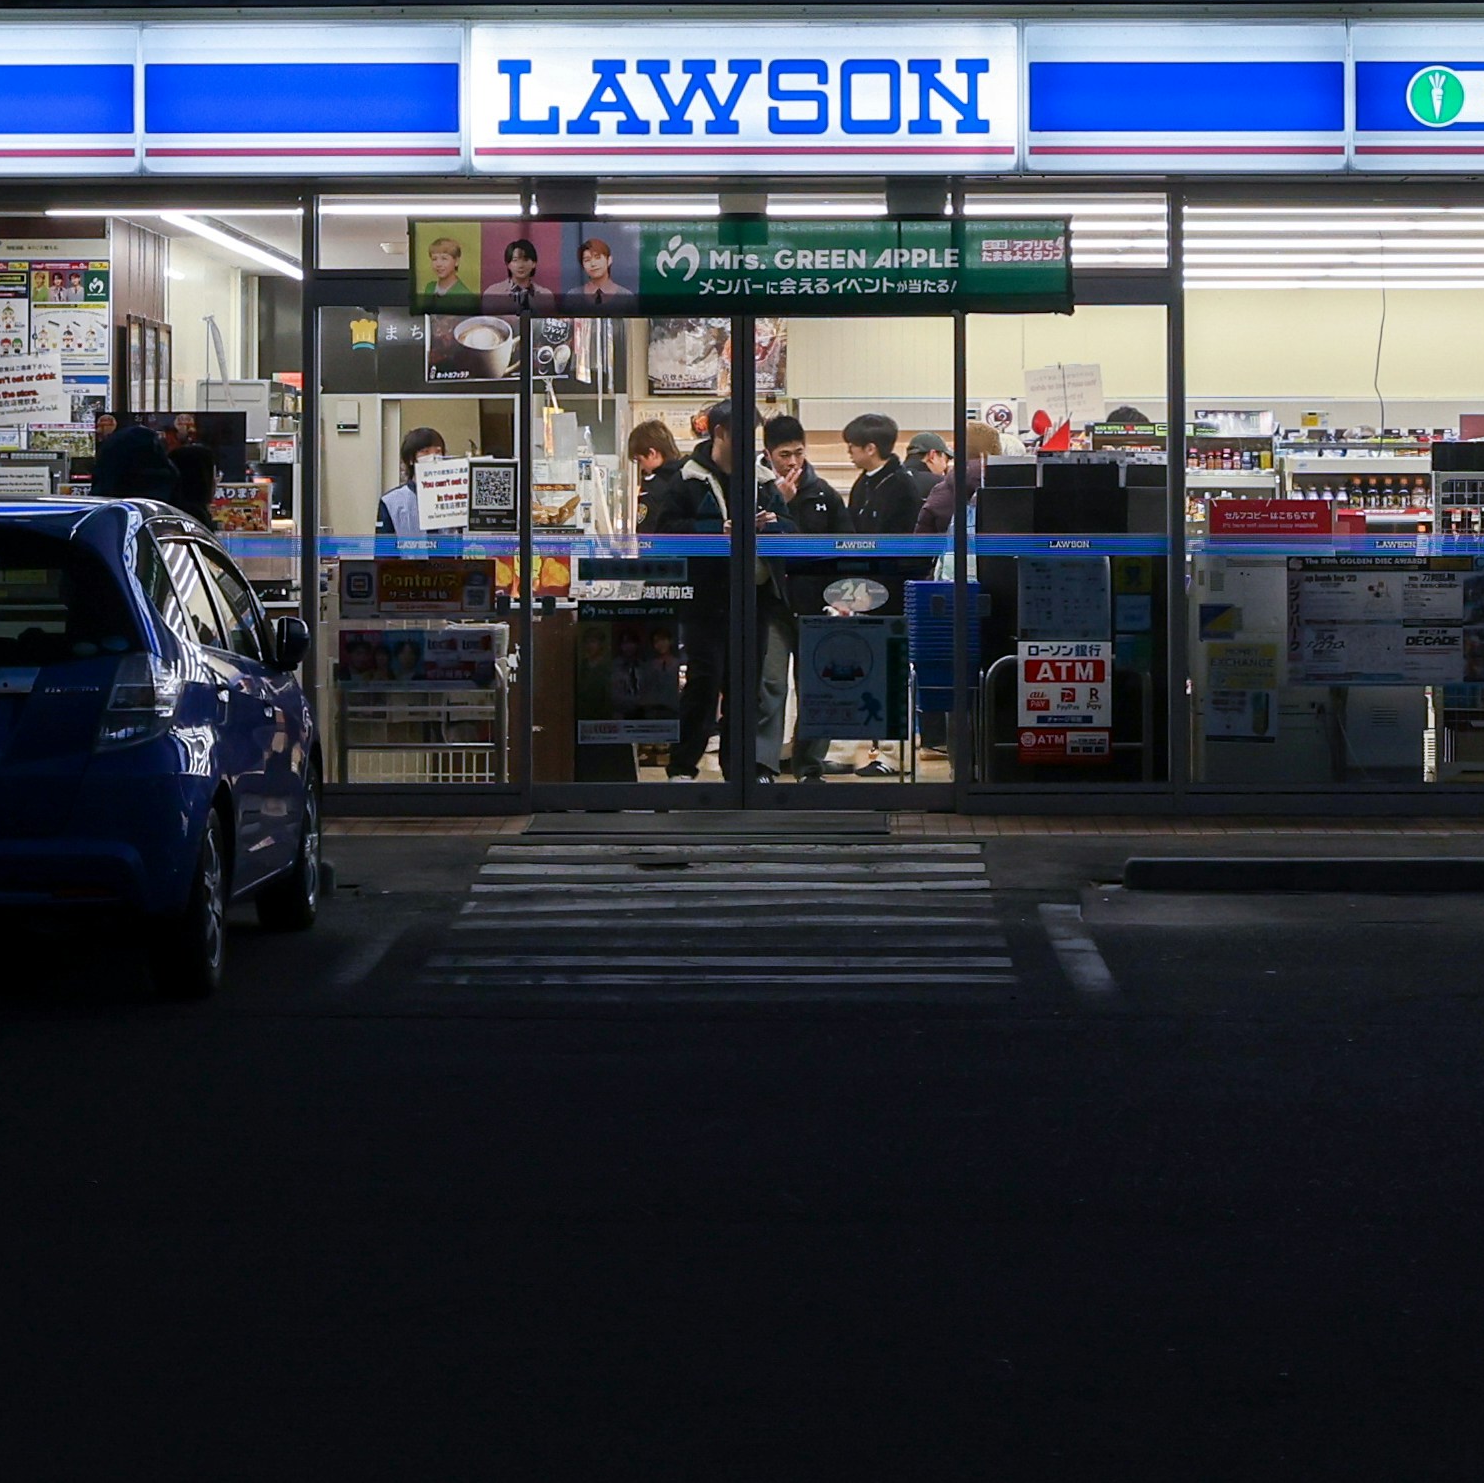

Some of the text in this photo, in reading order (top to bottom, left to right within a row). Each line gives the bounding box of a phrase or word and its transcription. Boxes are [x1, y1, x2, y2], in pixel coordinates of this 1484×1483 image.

[497, 58, 991, 136] LAWSON
[709, 249, 960, 270] Mrs. GREEN APPLE
[835, 540, 877, 550] LAWSON
[1048, 540, 1091, 550] LAWSON
[1405, 636, 1460, 646] DECADE
[1028, 645, 1102, 657] ローソン銀行
[1036, 661, 1095, 681] ATM
[1037, 734, 1065, 745] ATM
